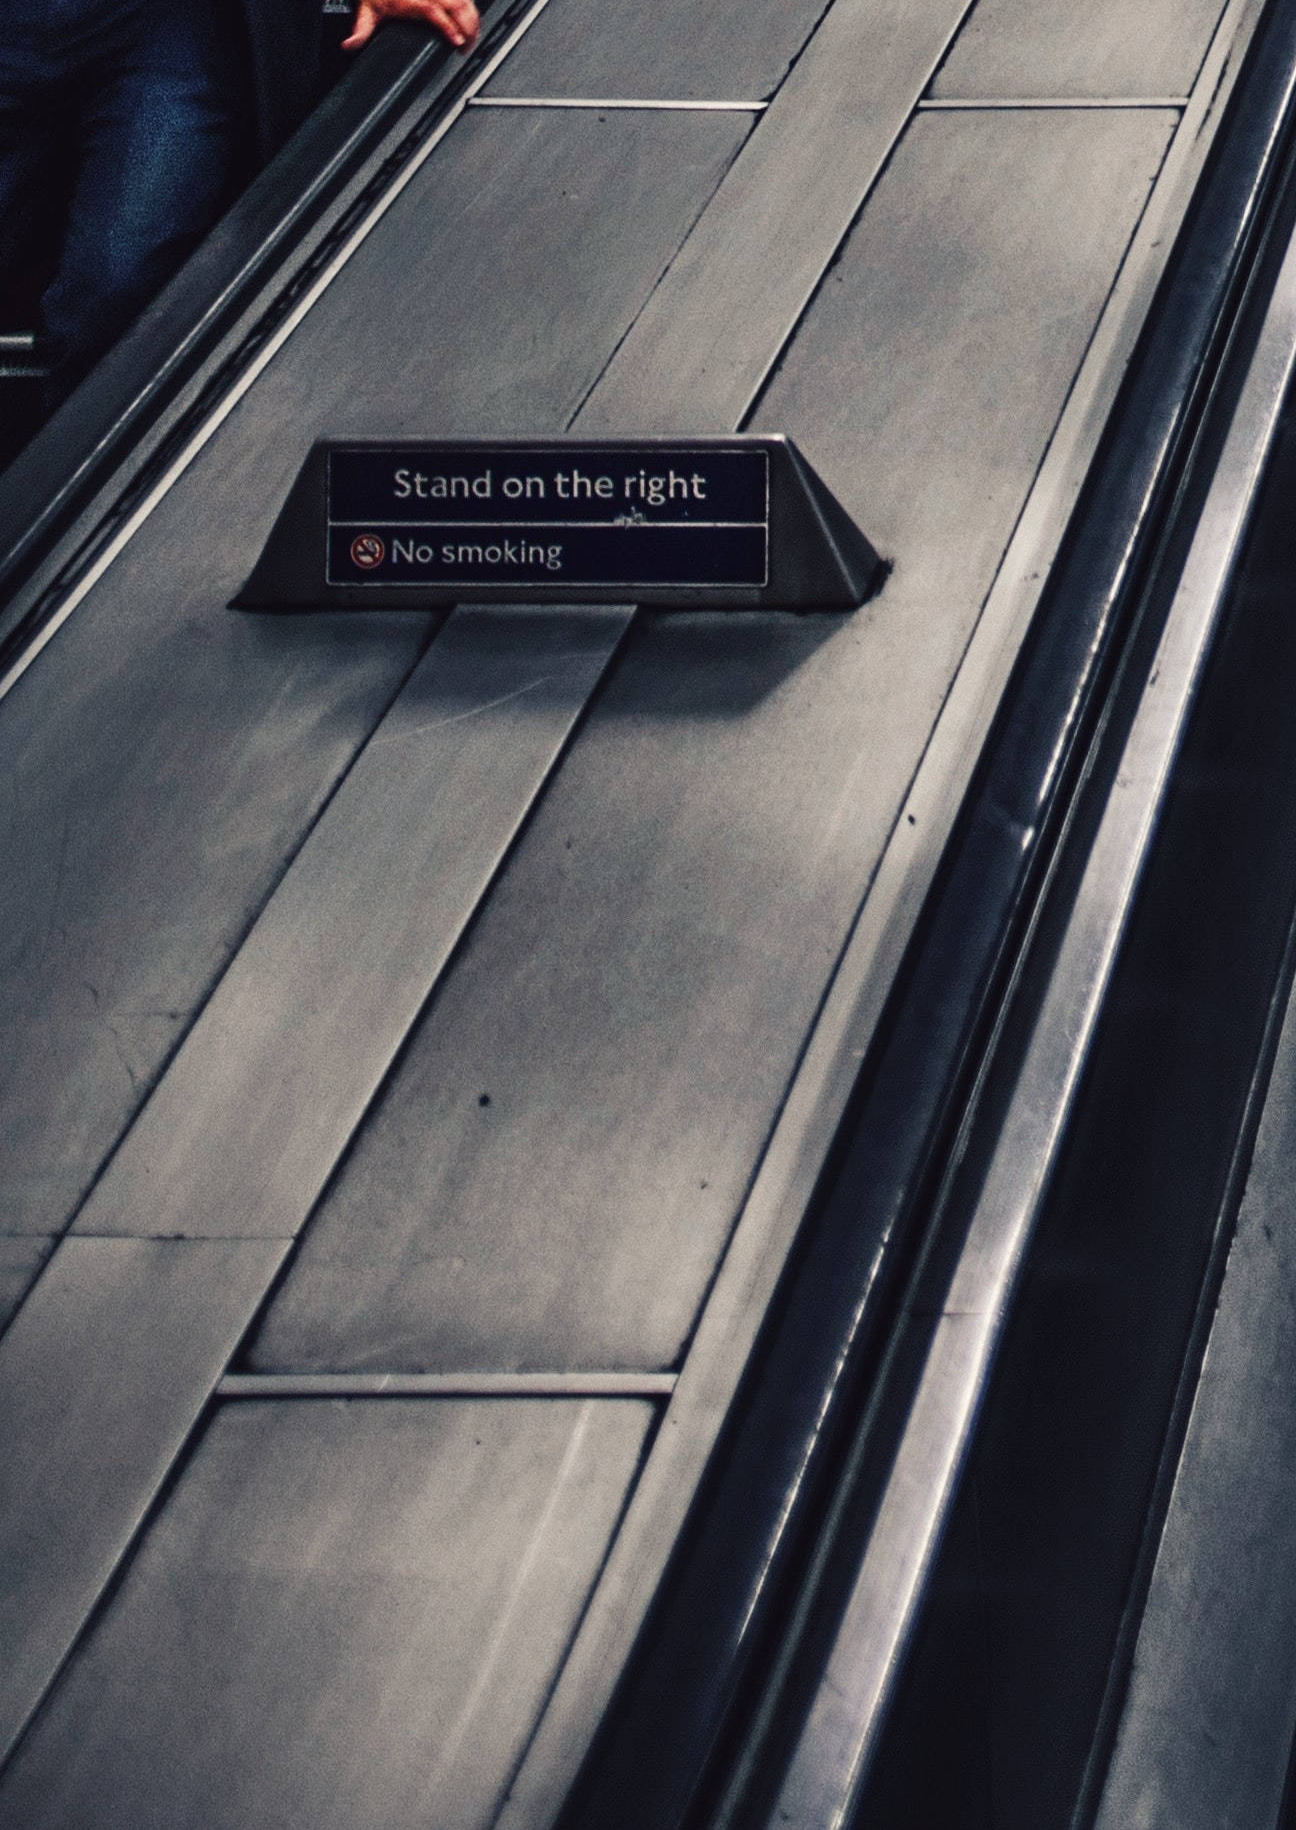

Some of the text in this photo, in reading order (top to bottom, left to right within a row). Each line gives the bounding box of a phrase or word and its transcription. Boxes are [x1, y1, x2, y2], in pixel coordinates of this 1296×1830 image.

[392, 468, 707, 506] Stand on the right
[391, 538, 563, 571] No smoking
